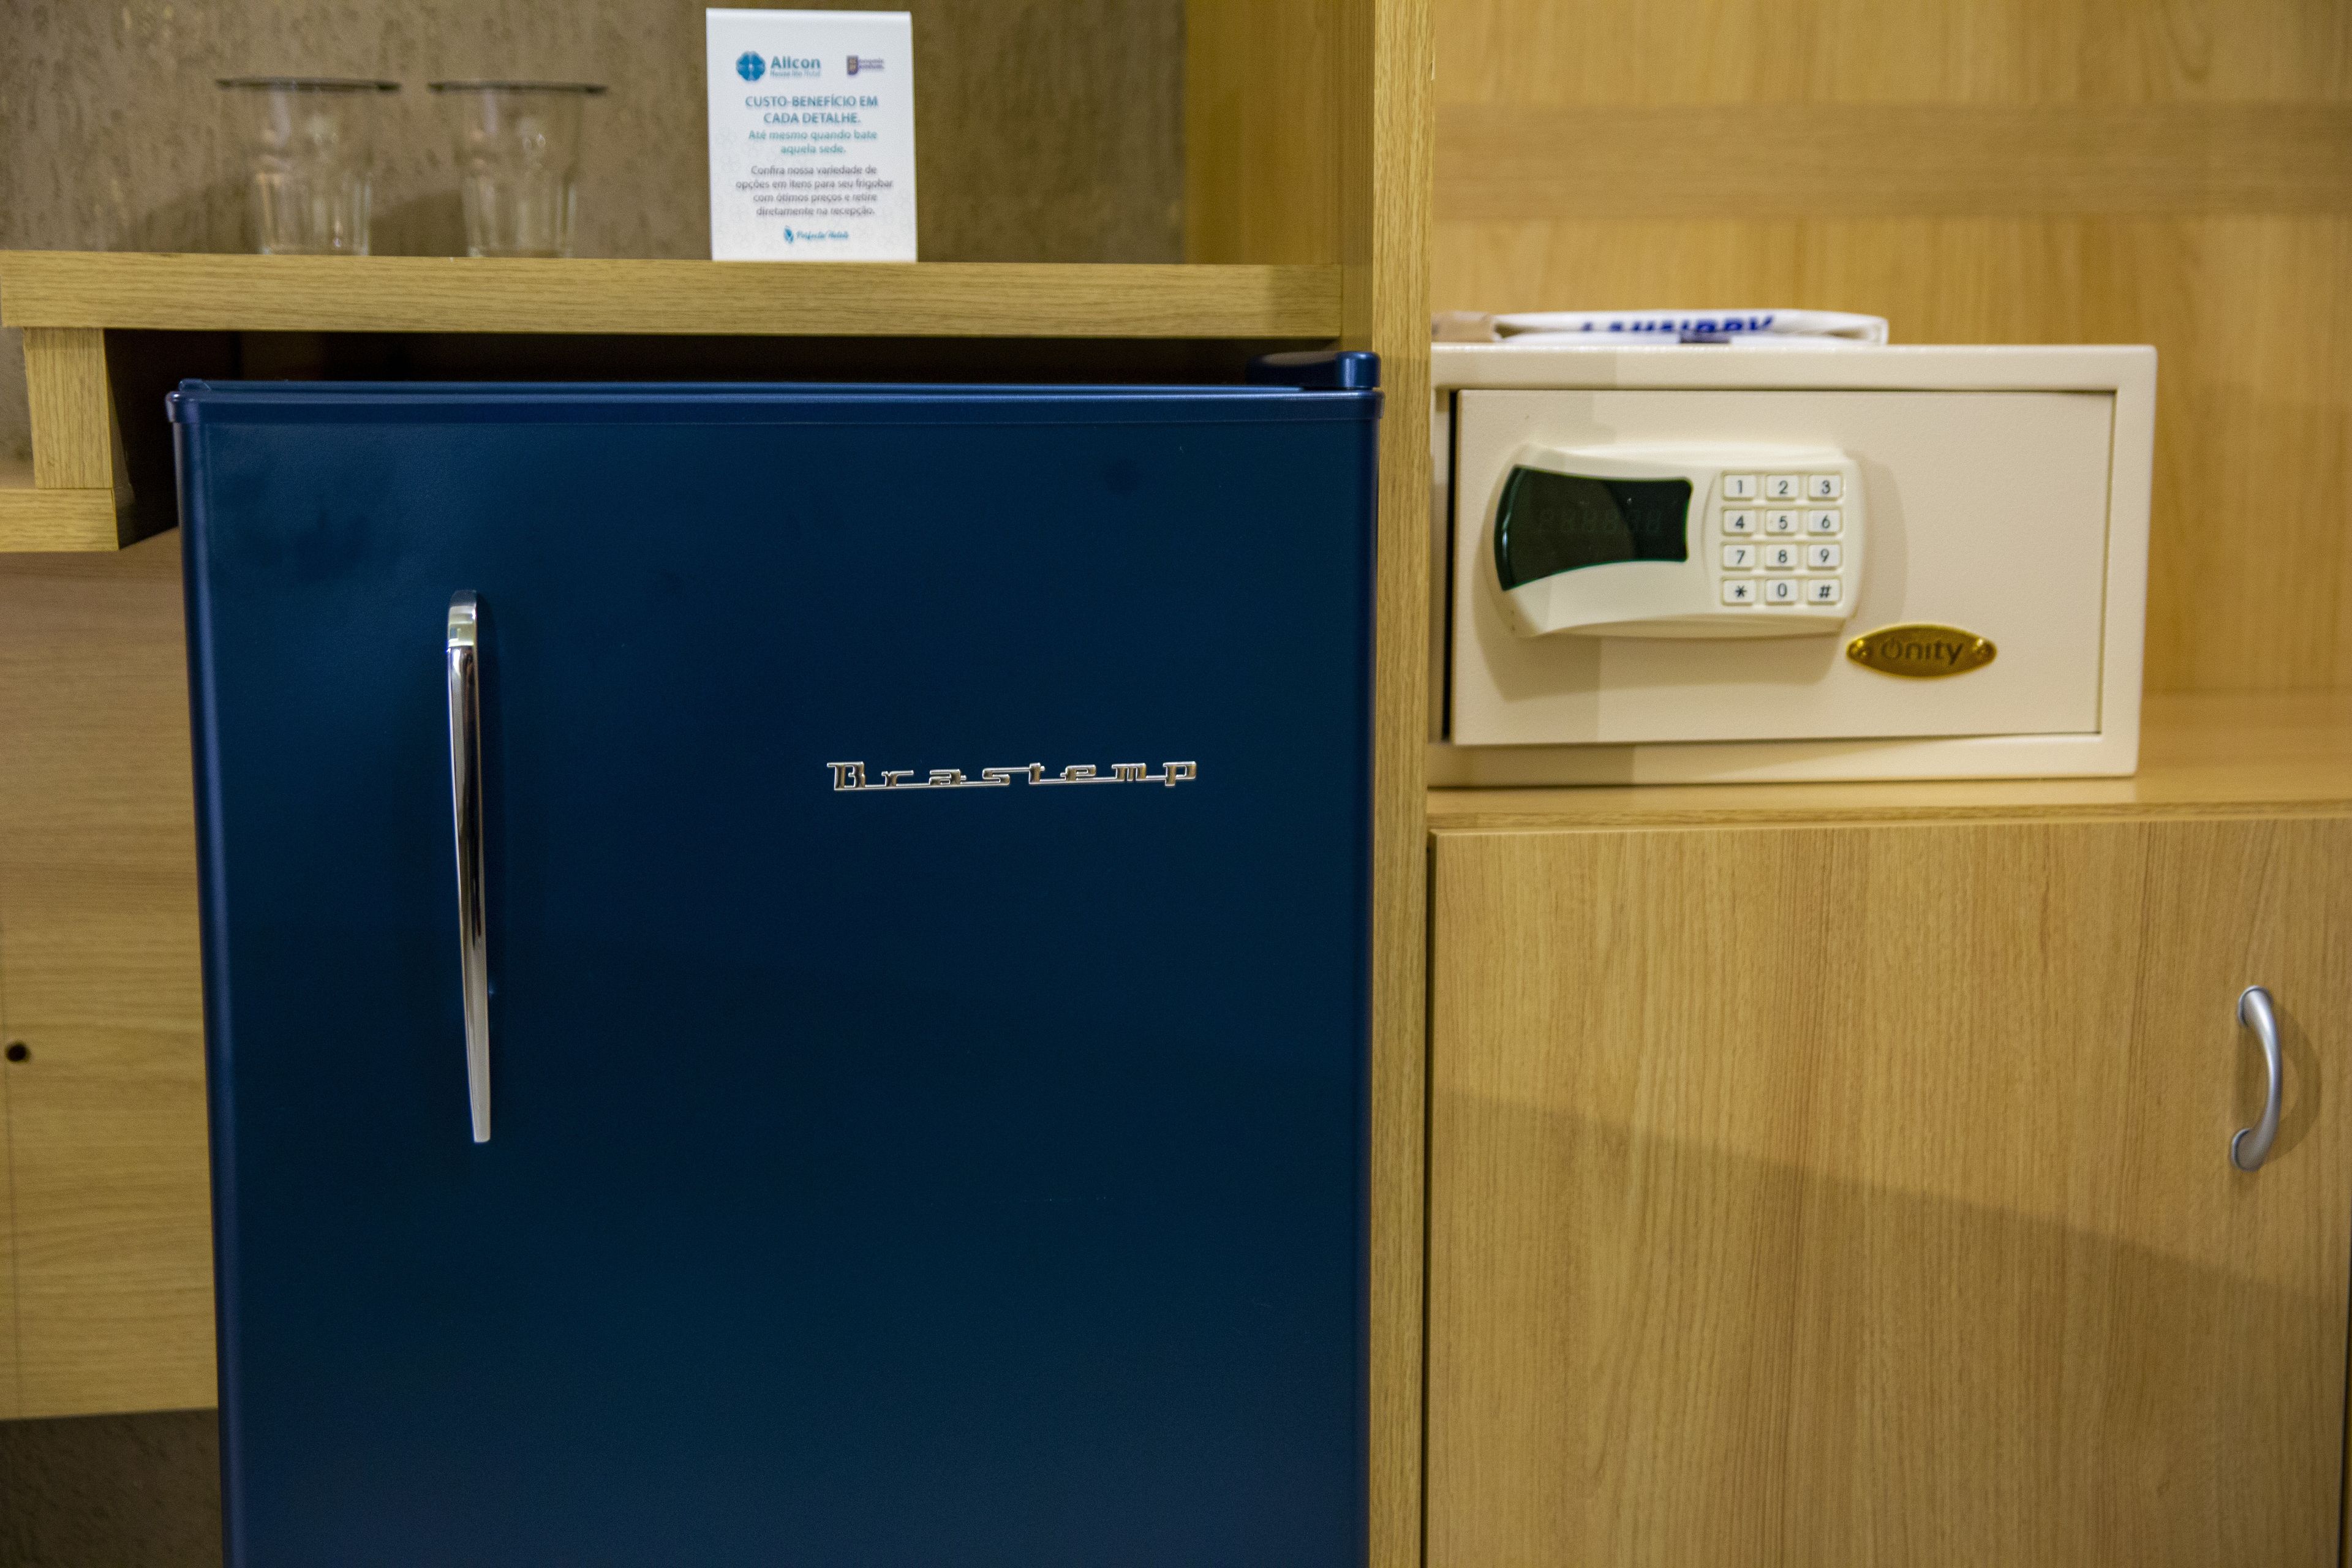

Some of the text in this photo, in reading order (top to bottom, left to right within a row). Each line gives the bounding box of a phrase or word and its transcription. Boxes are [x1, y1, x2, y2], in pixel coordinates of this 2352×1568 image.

[771, 56, 821, 69] Allcon
[745, 94, 878, 107] CUSTO-BENEFÍCIO EM
[763, 113, 861, 124] CADA DETALHE.
[748, 129, 877, 141] Até mesmo quando bate
[781, 143, 846, 154] aquela sede.
[751, 165, 785, 175] Confira
[816, 165, 862, 175] variedade
[865, 165, 877, 174] de
[736, 179, 770, 190] opções
[789, 179, 812, 188] itens
[776, 193, 809, 202] ótimos
[811, 194, 842, 203] preços
[756, 206, 814, 216] diretamente
[1736, 480, 1831, 495] 1 2 3
[1735, 514, 1831, 530] 4 5 6
[1736, 548, 1830, 564] 7 8 9
[1777, 583, 1787, 597] 0
[1881, 638, 1964, 666] Onity
[826, 761, 1197, 791] Brastemp
